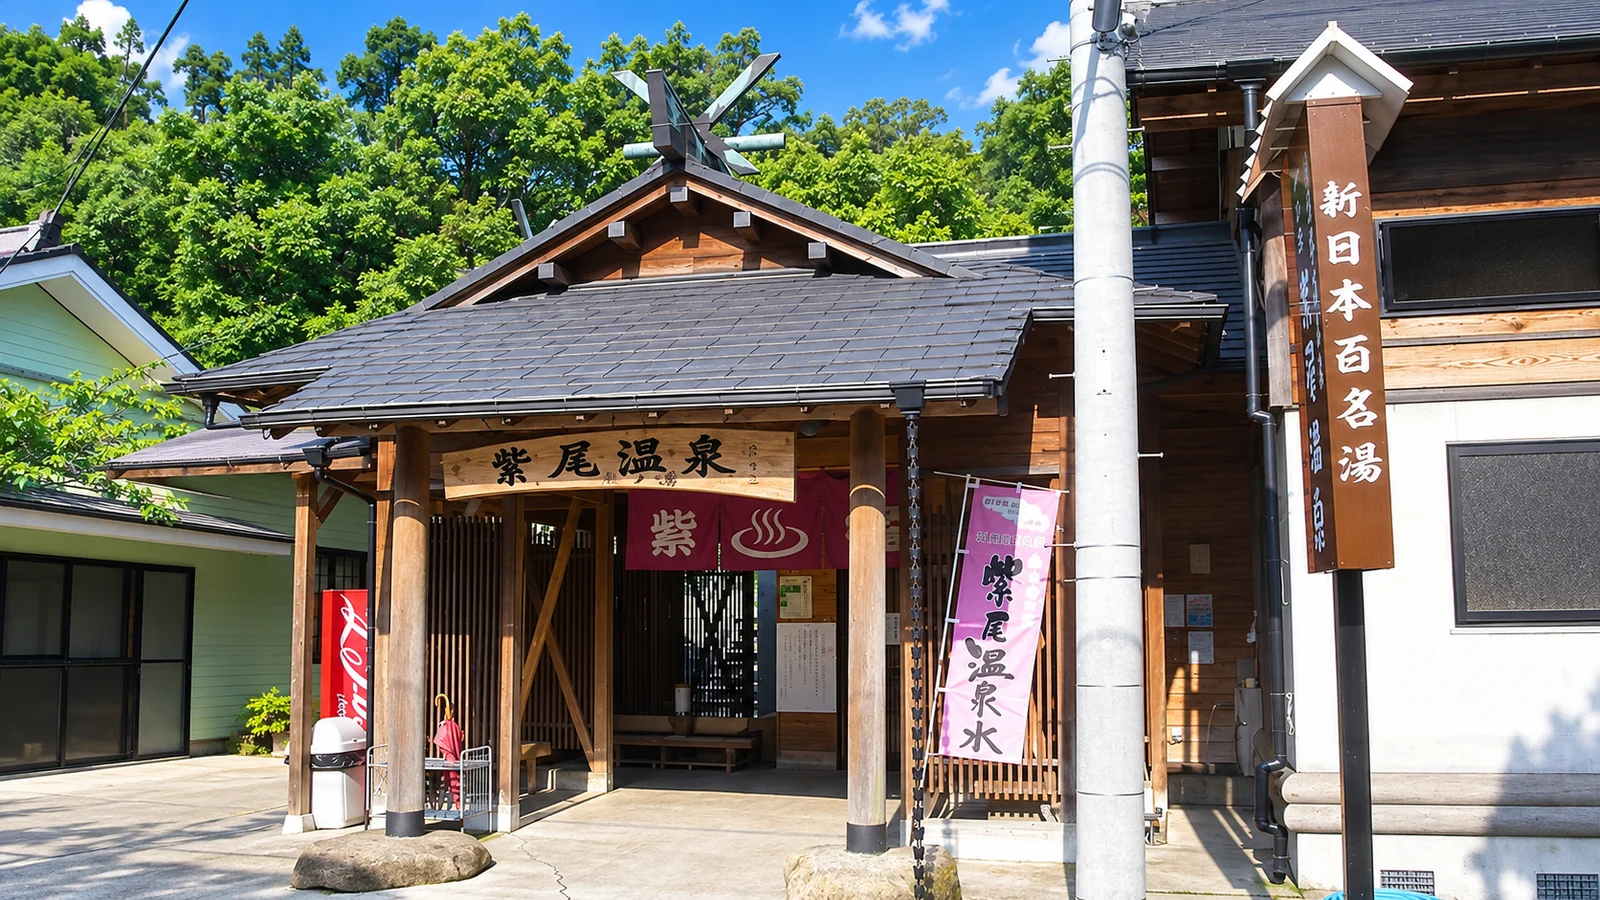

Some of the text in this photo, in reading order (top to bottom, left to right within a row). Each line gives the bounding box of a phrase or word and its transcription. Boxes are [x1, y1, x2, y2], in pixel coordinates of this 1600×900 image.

[1319, 180, 1382, 484] 新日本百名湯
[492, 434, 735, 486] 紫尾温泉
[650, 509, 698, 557] 紫
[959, 554, 1023, 755] 紫尾温泉水
